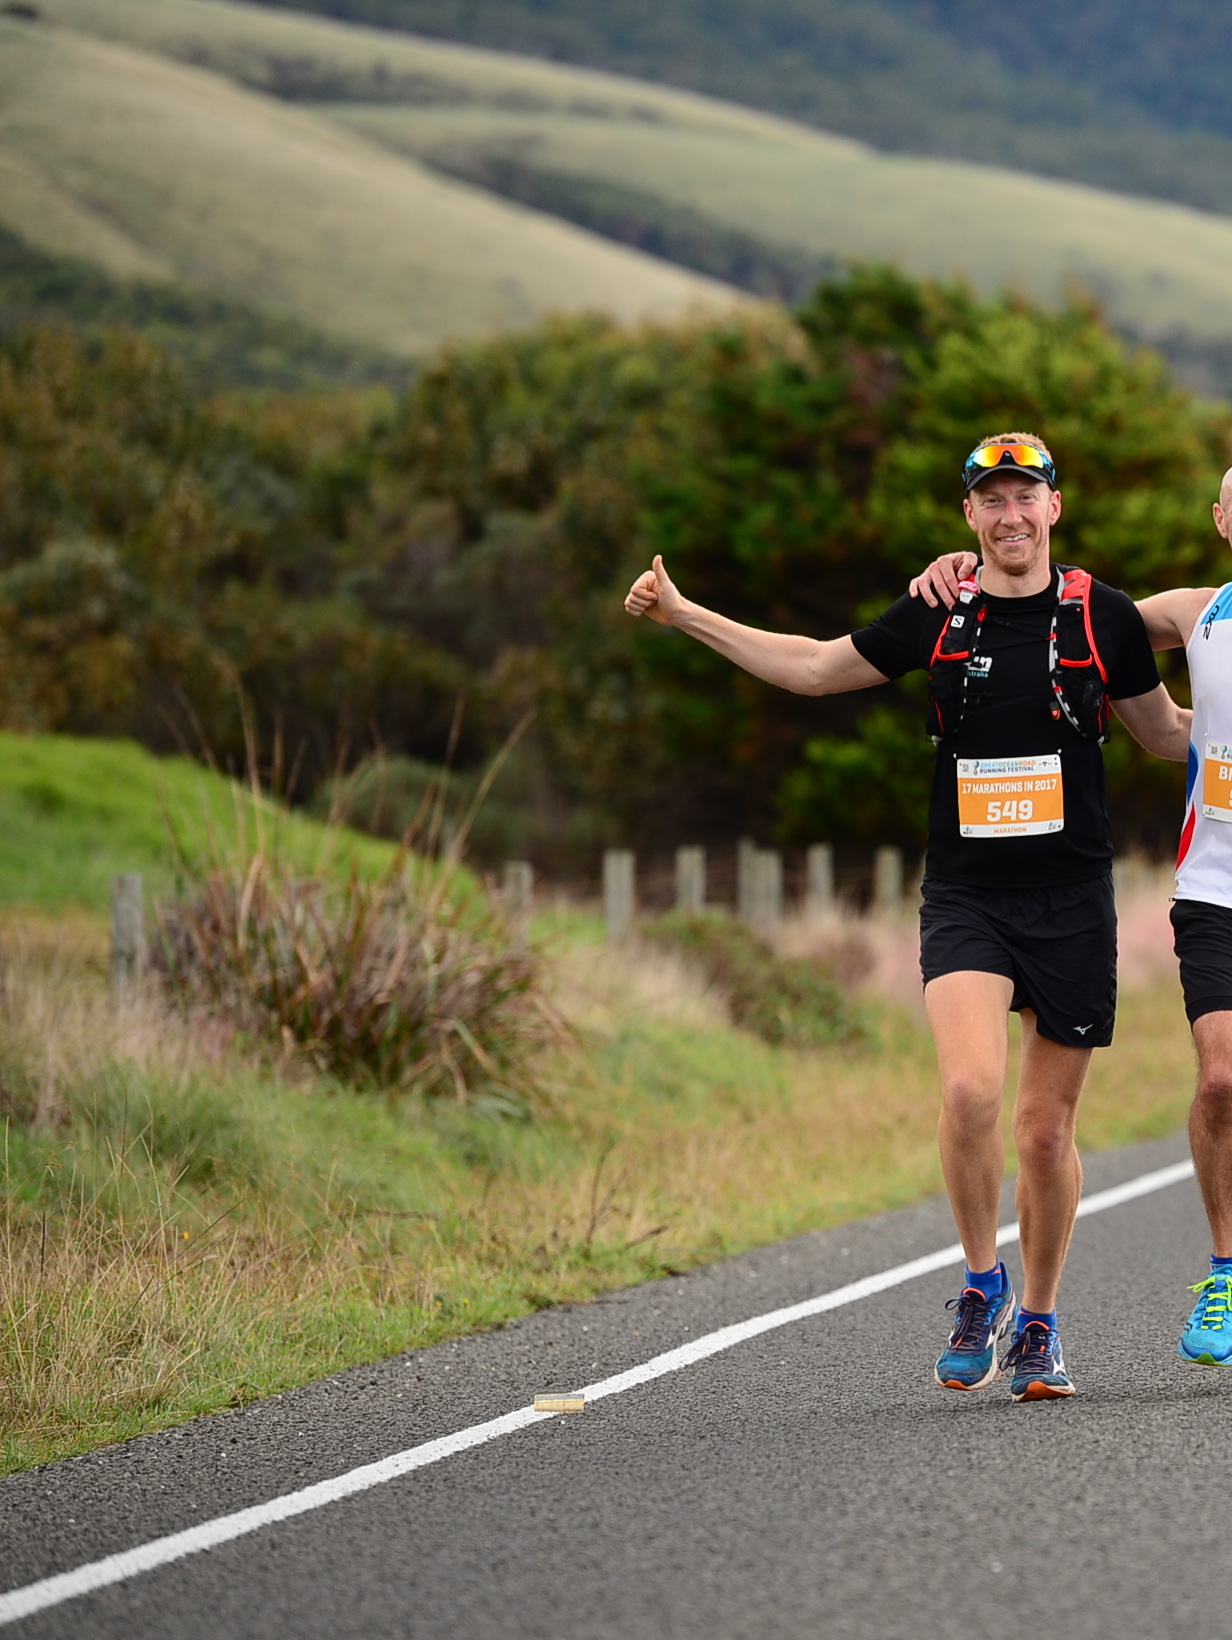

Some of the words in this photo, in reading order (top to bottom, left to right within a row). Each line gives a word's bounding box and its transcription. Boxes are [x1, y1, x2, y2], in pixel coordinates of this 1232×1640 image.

[962, 783, 972, 794] 17
[973, 781, 1023, 794] MARATHONS
[1024, 781, 1033, 792] IN
[1034, 779, 1057, 791] 2017
[986, 799, 1034, 822] 549
[994, 826, 1027, 834] MARATHON
